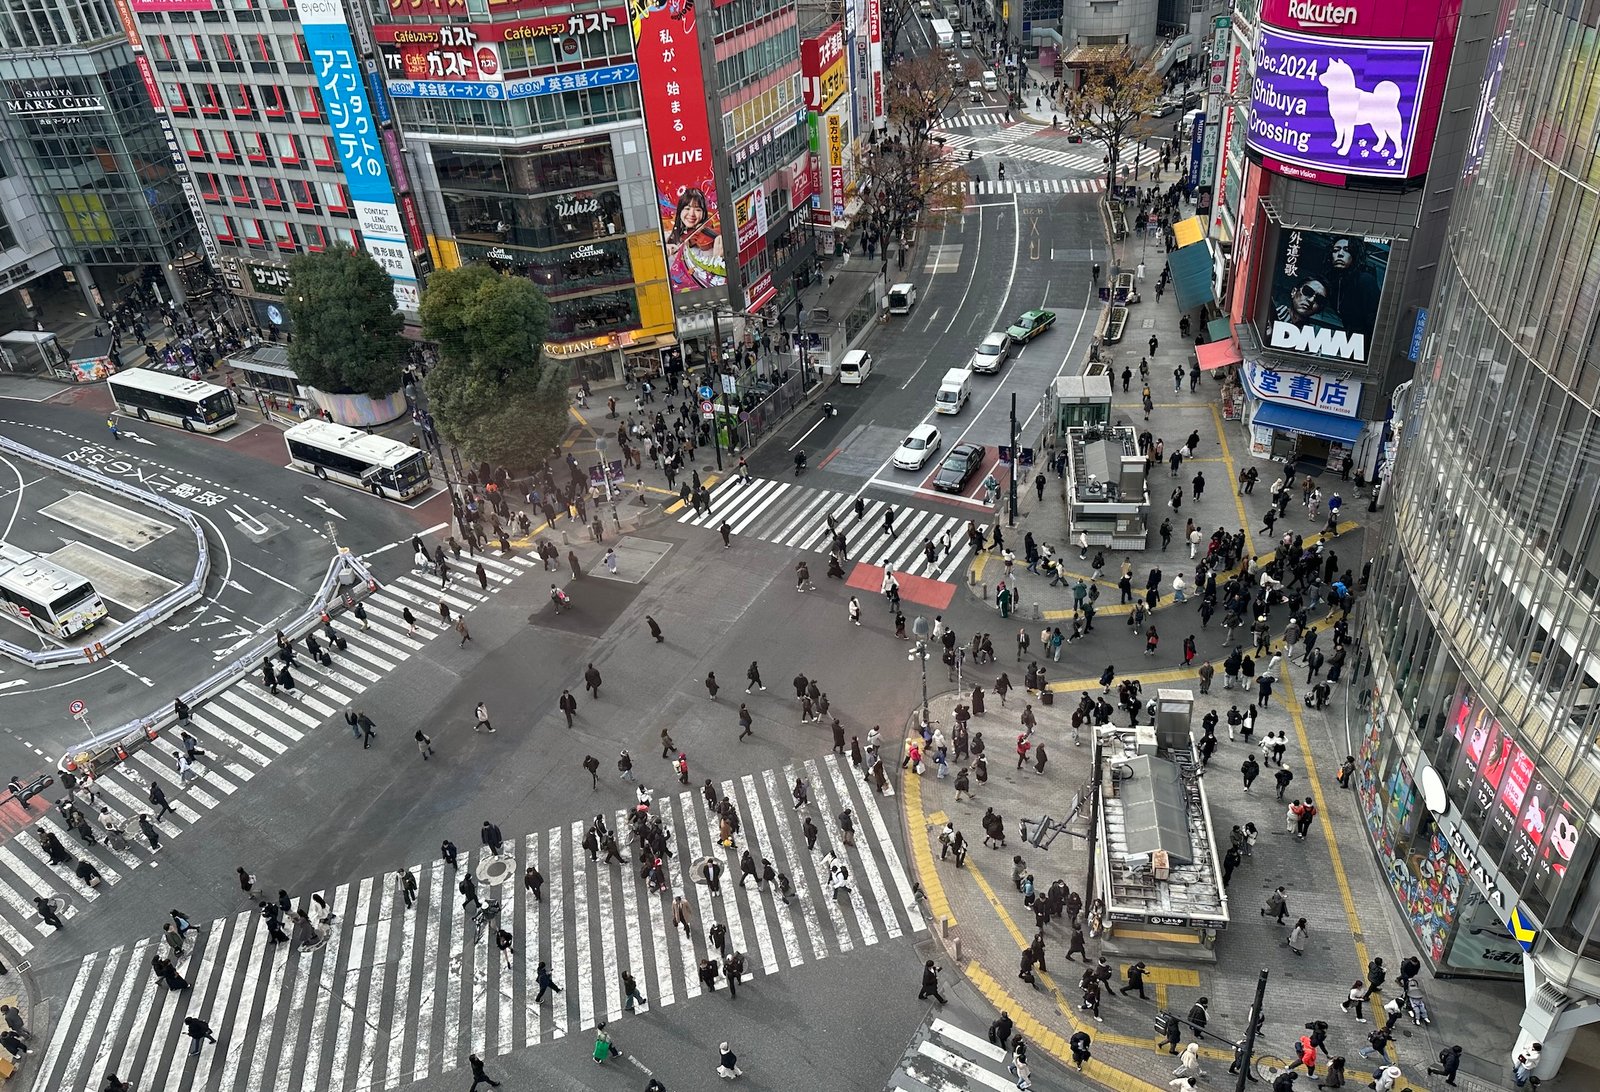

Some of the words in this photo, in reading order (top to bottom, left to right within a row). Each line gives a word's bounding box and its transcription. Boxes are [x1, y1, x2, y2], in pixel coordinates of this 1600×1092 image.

[567, 11, 616, 36] ガスト
[1288, 0, 1357, 24] Rakuten
[439, 27, 477, 46] ガスト
[384, 53, 402, 70] 7F
[405, 53, 426, 66] Café
[427, 50, 473, 77] ガスト
[479, 58, 496, 69] ガスト
[1257, 45, 1318, 81] Dec.2024
[392, 82, 413, 95] AEON
[419, 83, 483, 97] 英会話イーオン
[511, 81, 541, 95] AEON
[548, 66, 637, 91] 英会話イーオン
[6, 98, 60, 112] MARK
[62, 97, 102, 109] CITY
[25, 87, 73, 98] SHIBUYA
[1254, 78, 1307, 116] Shibuya
[314, 50, 363, 177] アイシティ
[336, 50, 382, 177] コンタクトの
[829, 117, 840, 152] 処方せん
[1196, 119, 1204, 144] MIZUHO
[1249, 109, 1311, 153] Crossing
[662, 148, 703, 168] 17LIVE
[1300, 169, 1317, 179] Vision
[832, 169, 843, 204] スギ薬局
[364, 207, 389, 216] CONTACT
[371, 216, 387, 224] LENS
[555, 199, 599, 218] Ushi8
[788, 203, 809, 232] LUSH
[364, 222, 399, 233] SPECIALISTS
[1284, 231, 1303, 278] 外道の歌
[1270, 320, 1365, 361] DMM
[1448, 821, 1502, 907] TSUTAYA
